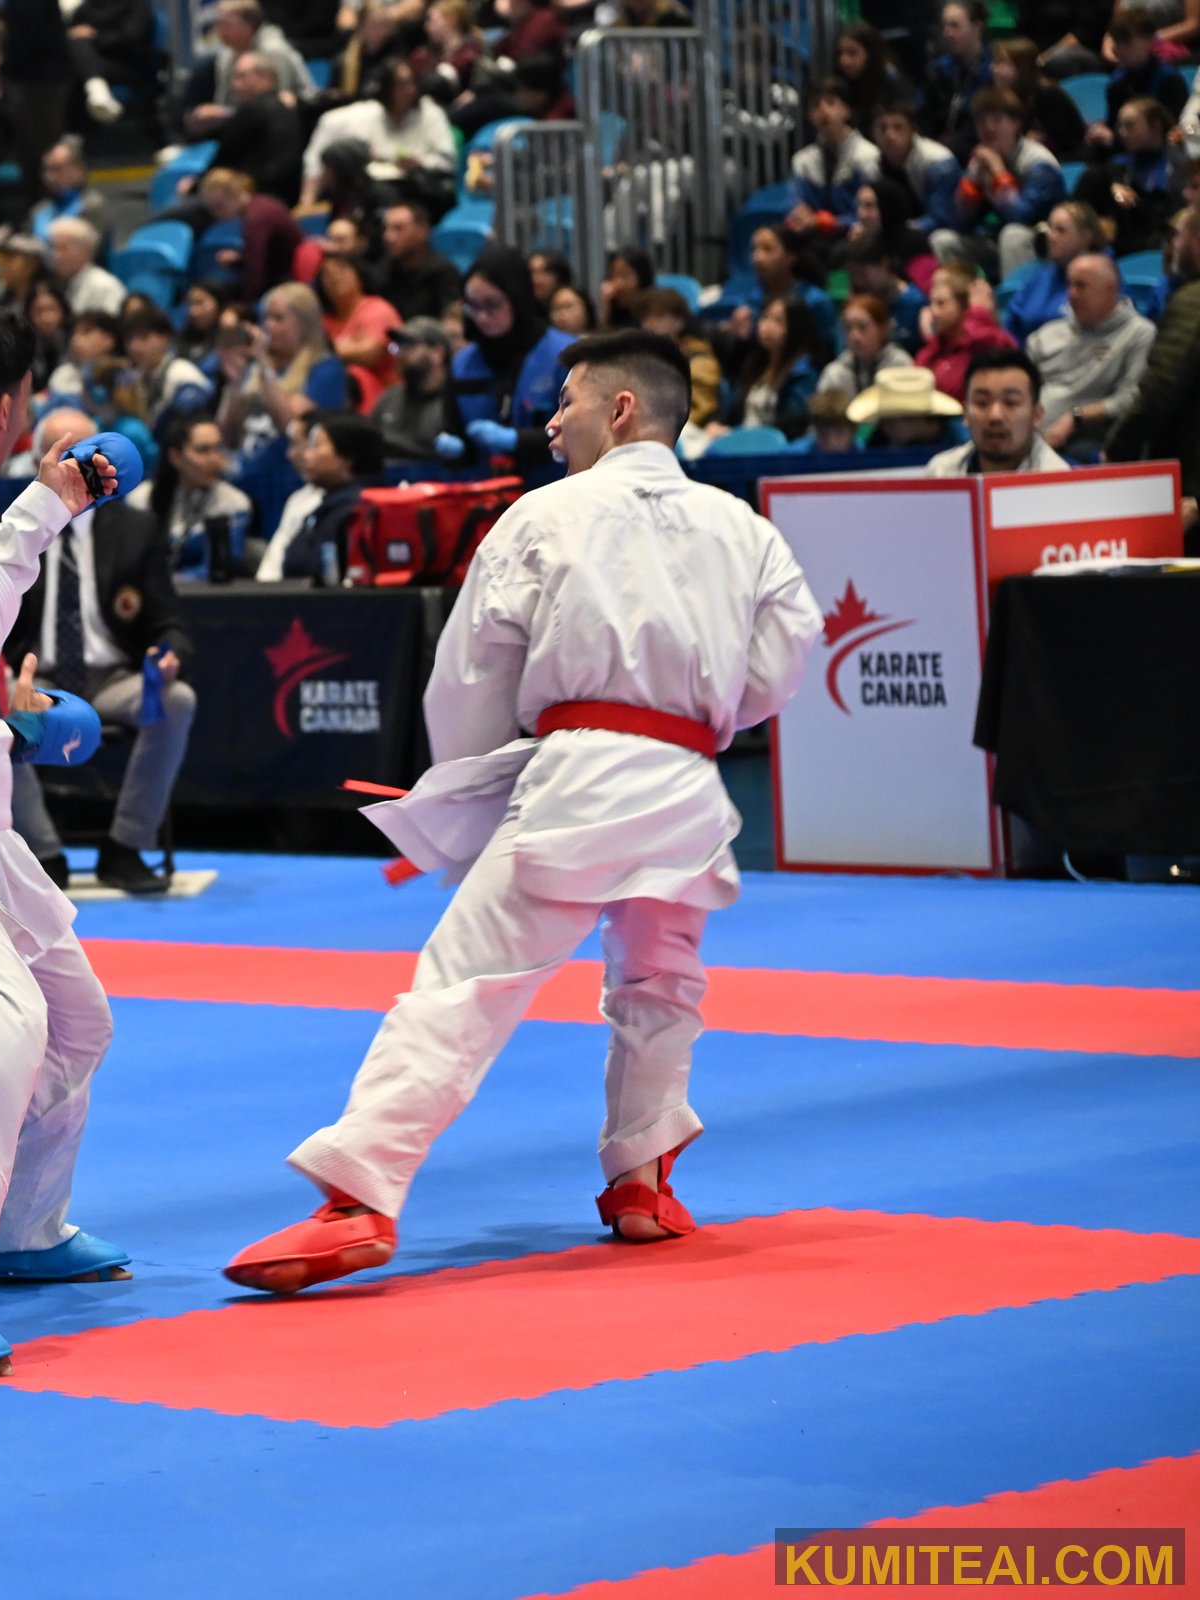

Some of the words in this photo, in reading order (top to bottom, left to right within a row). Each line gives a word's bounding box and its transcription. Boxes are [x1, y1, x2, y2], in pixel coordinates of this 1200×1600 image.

[859, 652, 943, 677] KARATE
[301, 681, 379, 704] KARATE
[861, 682, 947, 706] CANADA
[301, 707, 381, 733] CANADA
